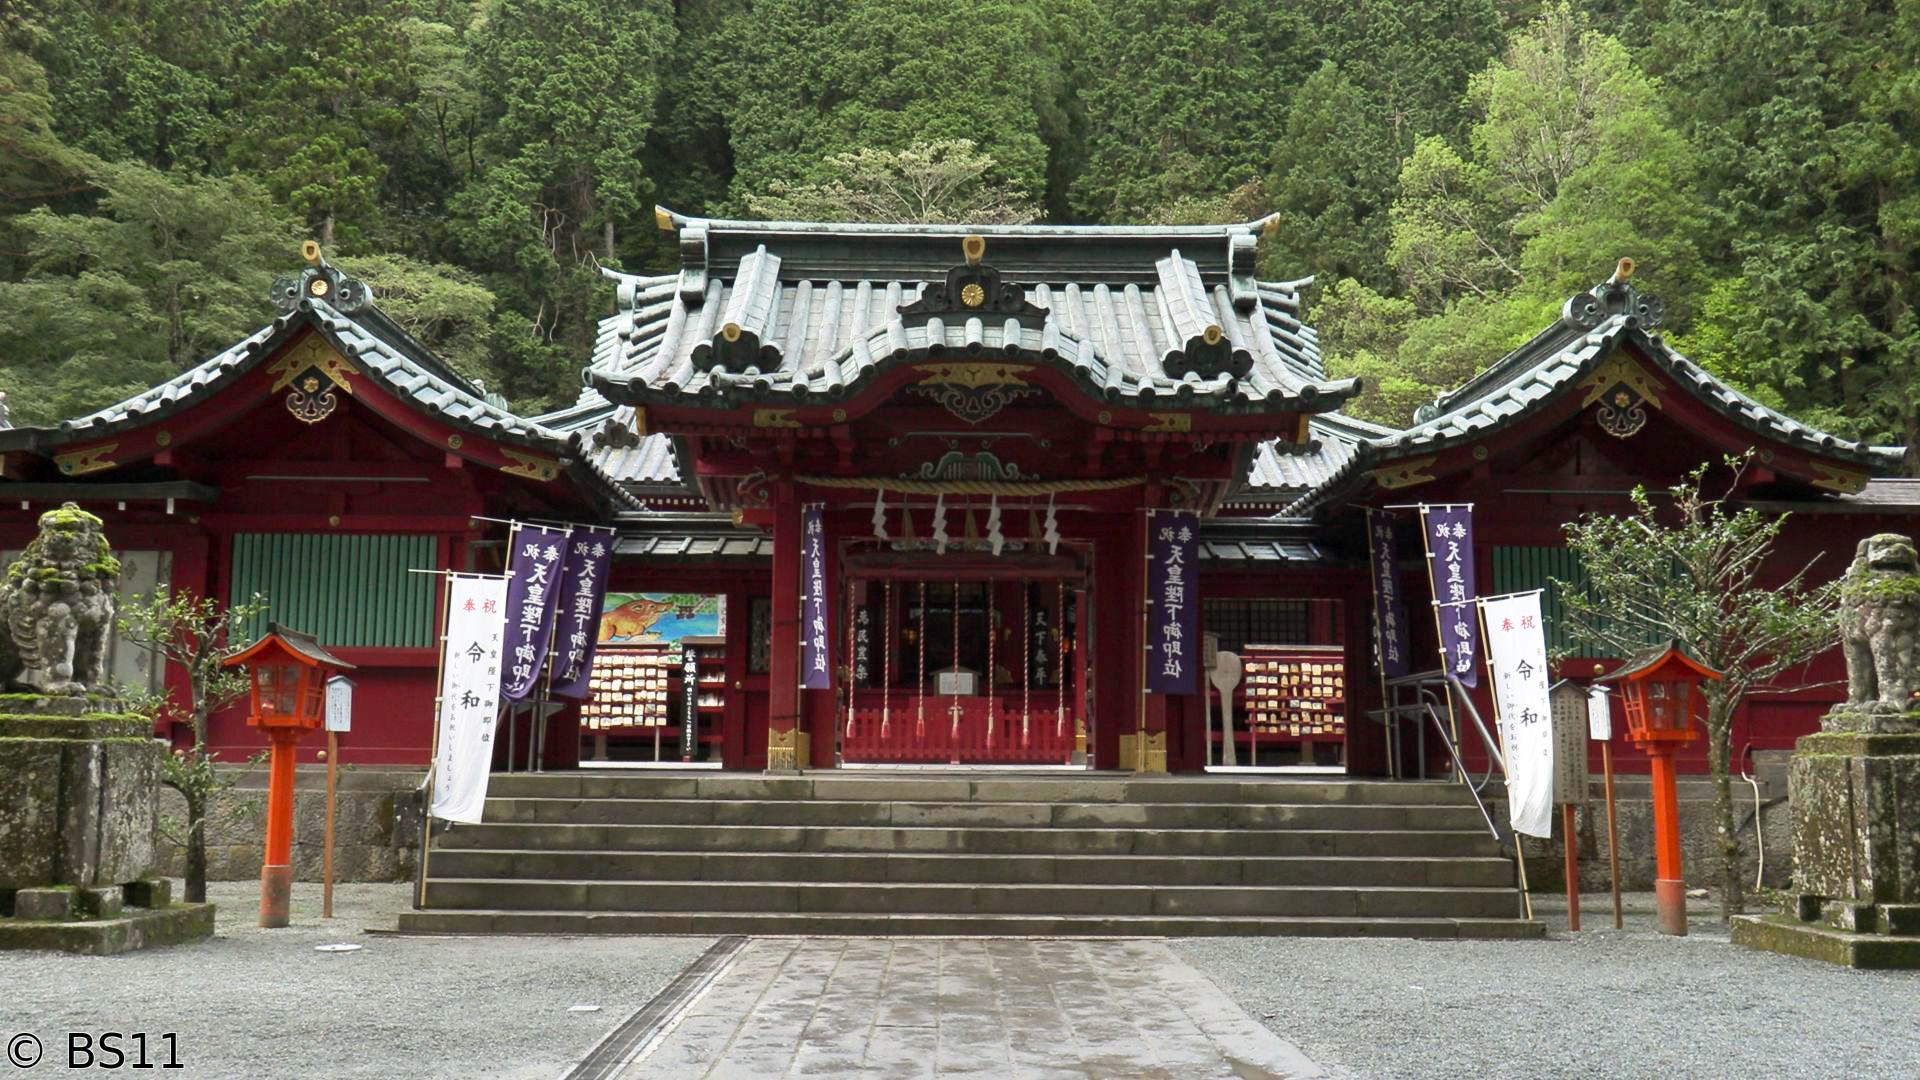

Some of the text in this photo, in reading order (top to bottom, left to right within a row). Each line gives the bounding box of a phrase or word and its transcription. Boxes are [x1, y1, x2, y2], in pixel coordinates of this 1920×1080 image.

[463, 598, 497, 614] 奉祝
[1501, 616, 1536, 632] 奉祝
[461, 641, 486, 709] 令和
[482, 633, 498, 742] 天皇陛下御即位
[1516, 660, 1538, 727] 令和
